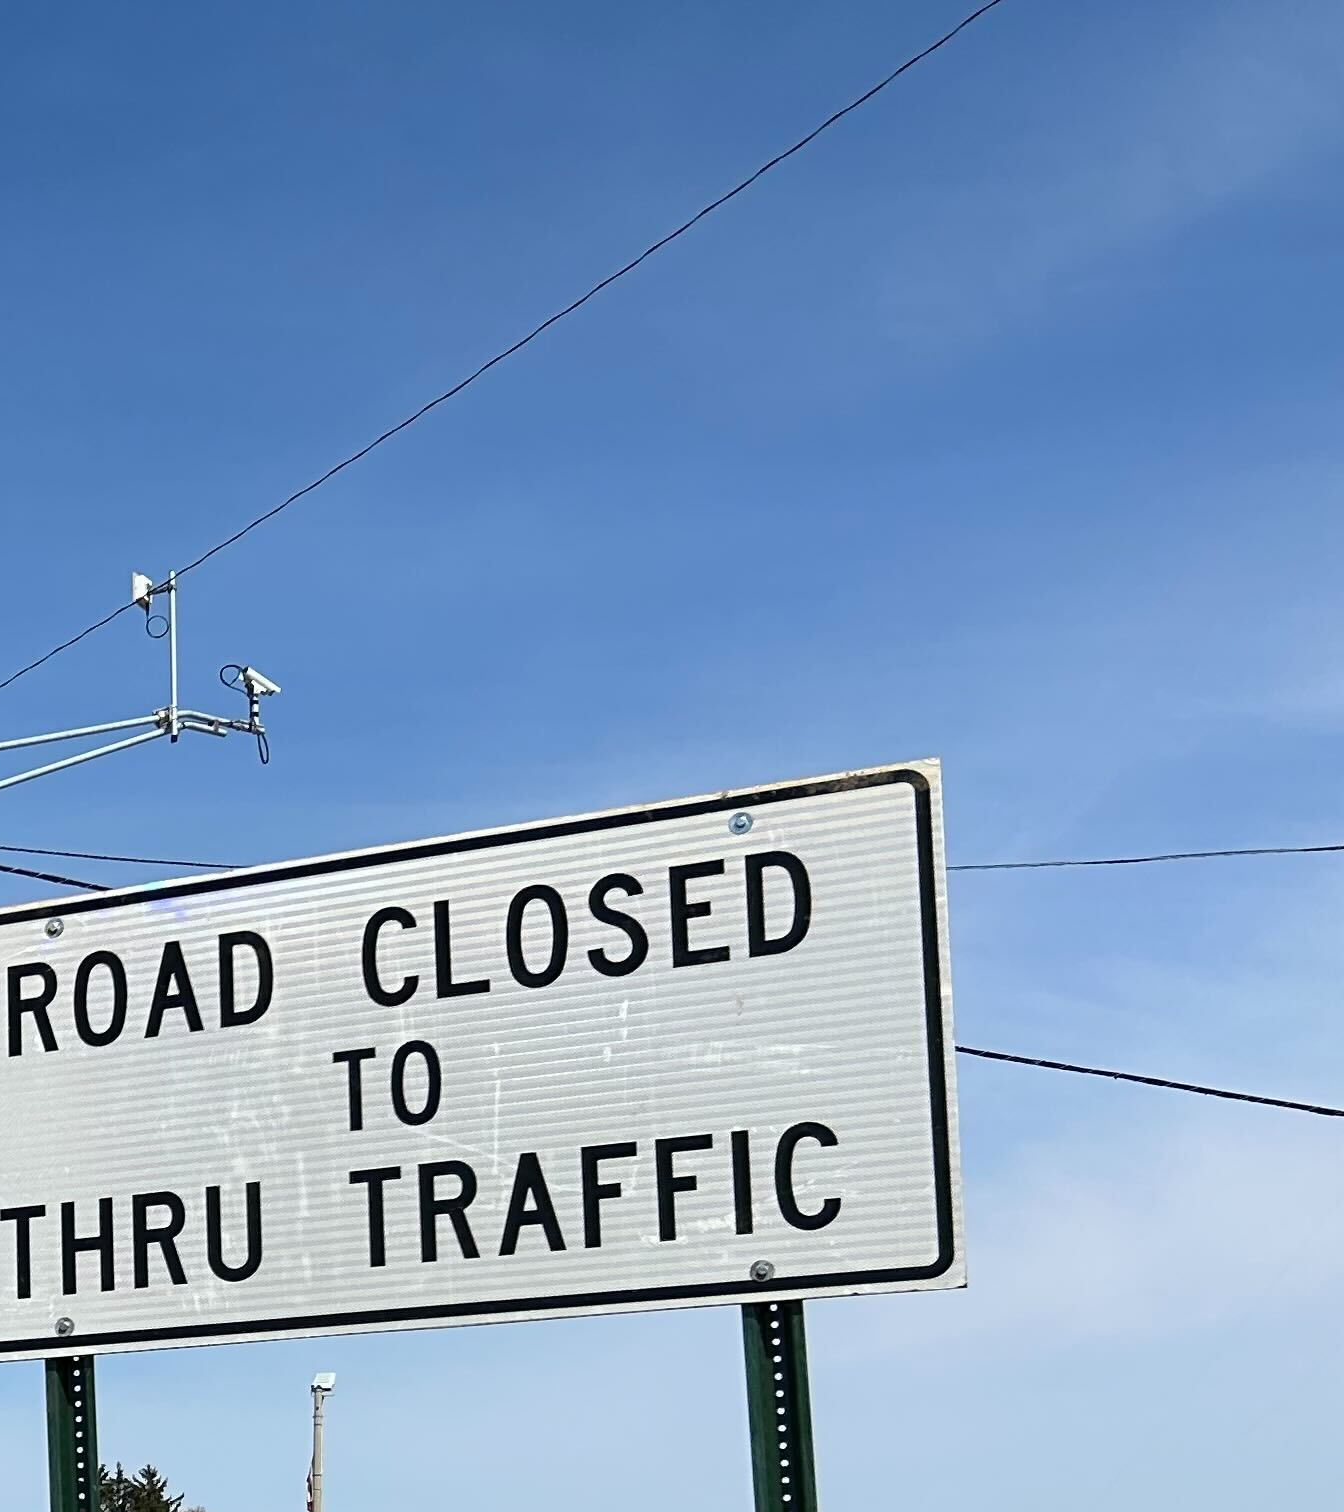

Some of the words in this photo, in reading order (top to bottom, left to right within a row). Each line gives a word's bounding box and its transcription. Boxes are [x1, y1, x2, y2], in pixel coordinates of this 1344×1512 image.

[6, 929, 274, 1058] ROAD
[361, 850, 811, 1008] CLOSED
[332, 1040, 442, 1132] TO
[0, 1181, 263, 1300] THRU
[349, 1121, 842, 1268] TRAFFIC
